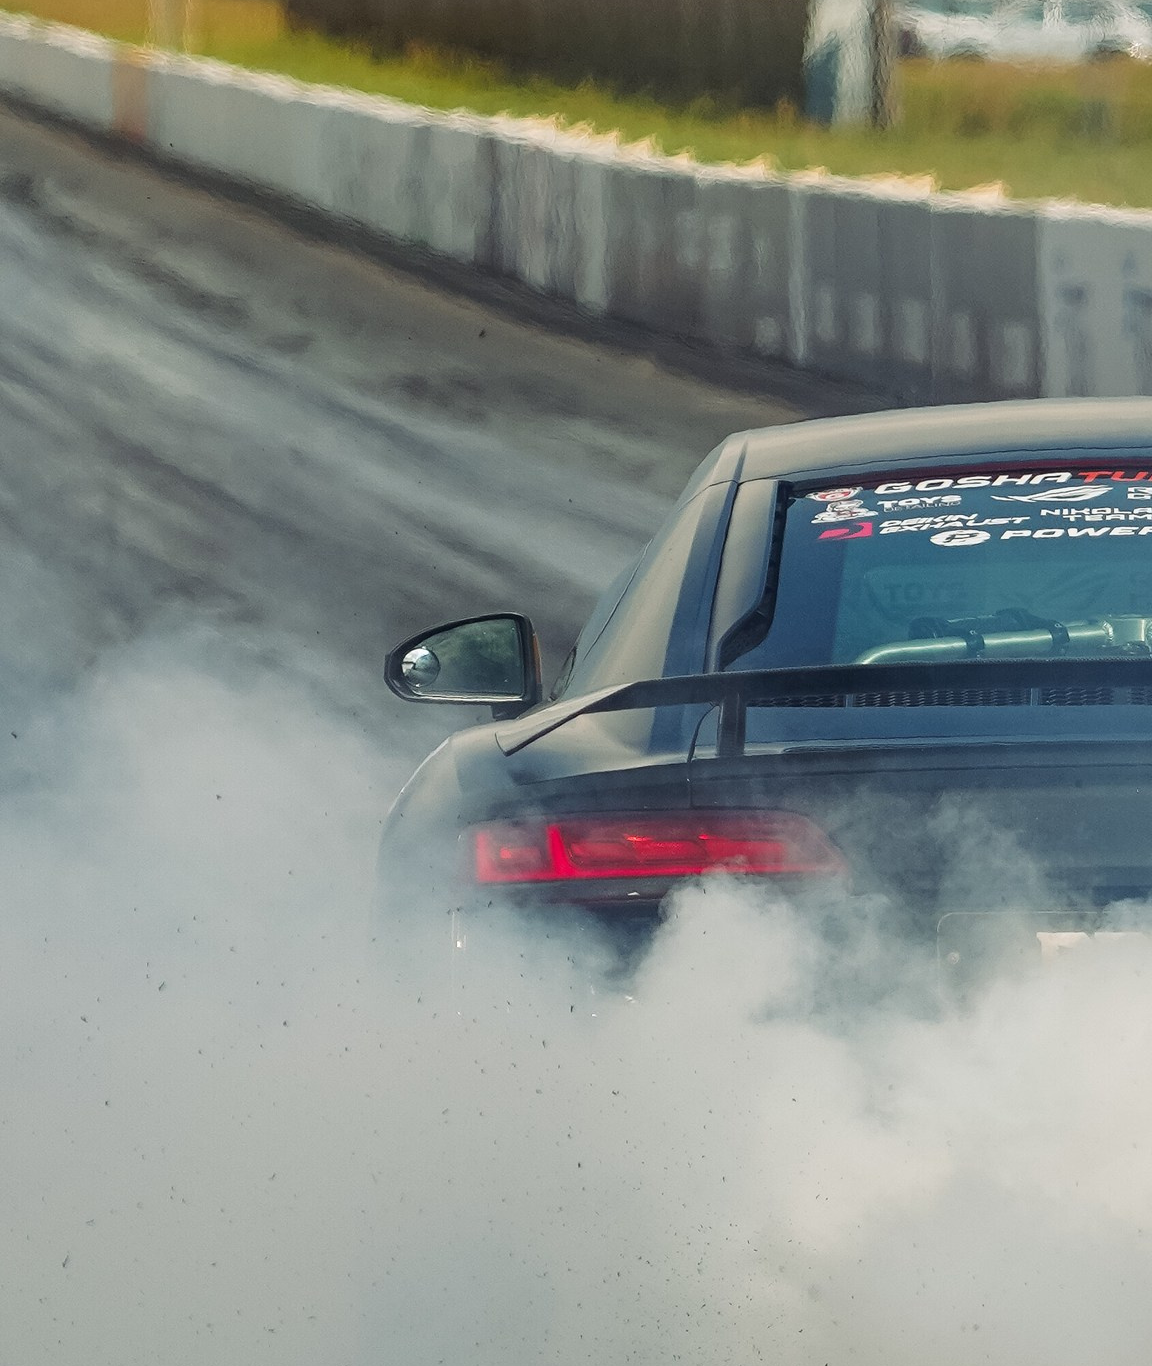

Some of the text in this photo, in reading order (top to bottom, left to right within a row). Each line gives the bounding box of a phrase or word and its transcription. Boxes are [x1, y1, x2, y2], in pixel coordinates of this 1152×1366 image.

[877, 494, 963, 510] TOYS
[879, 516, 1031, 535] EXHAUST
[1062, 514, 1152, 522] TEAM
